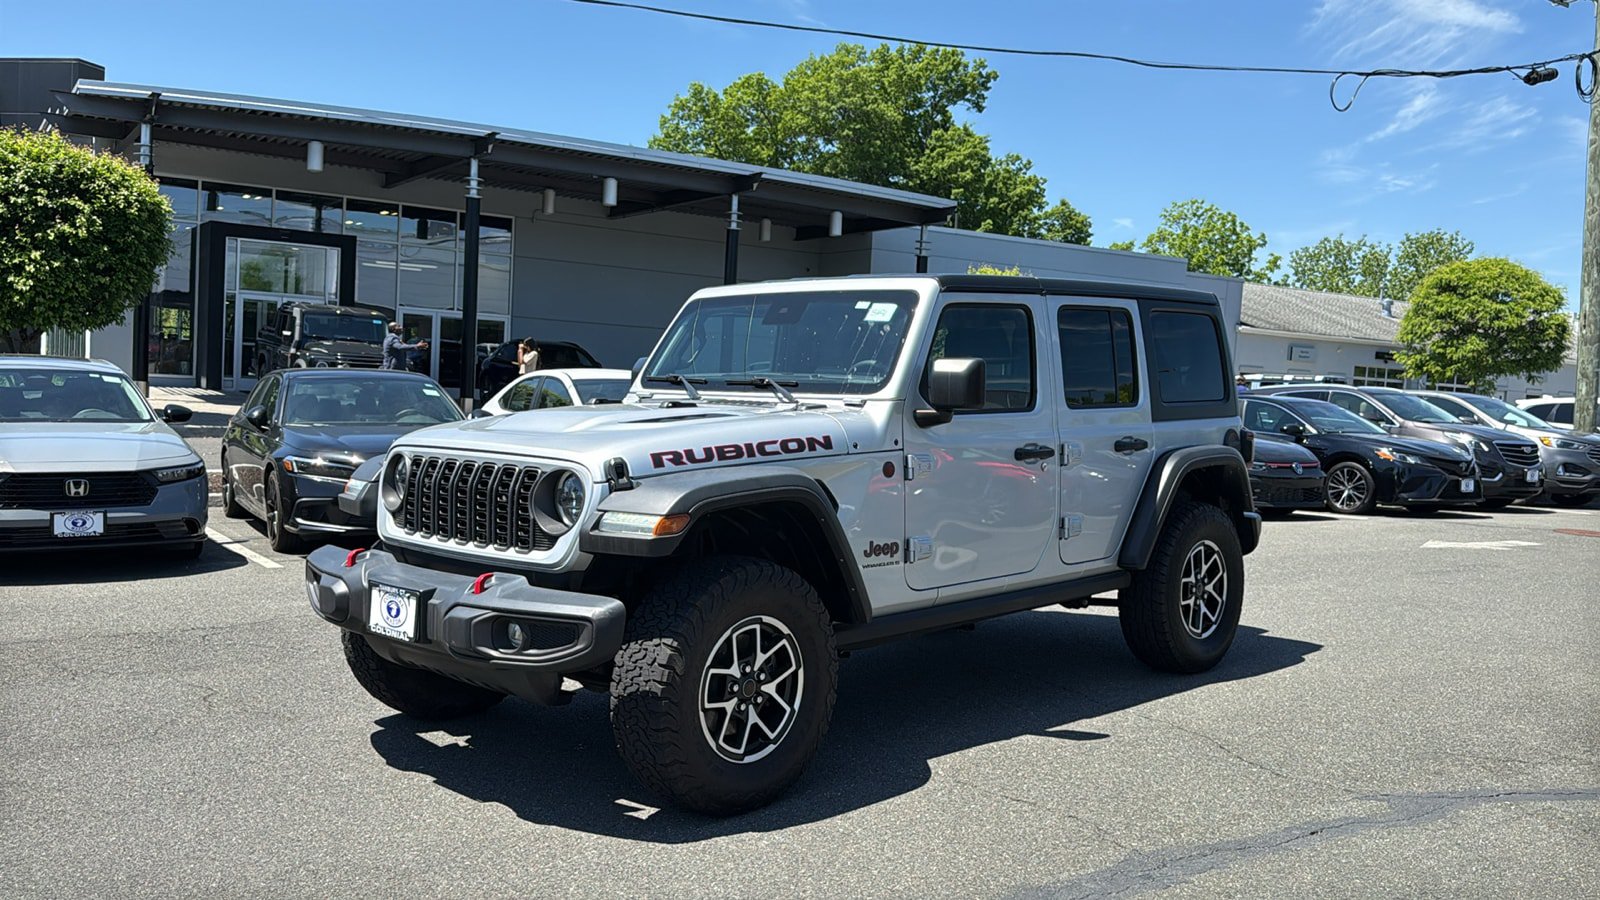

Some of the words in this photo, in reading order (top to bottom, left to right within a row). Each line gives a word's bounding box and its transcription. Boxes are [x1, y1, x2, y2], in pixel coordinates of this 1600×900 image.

[650, 435, 833, 469] RUBICON
[863, 540, 900, 558] Jeep
[370, 624, 410, 642] COLONIAL
